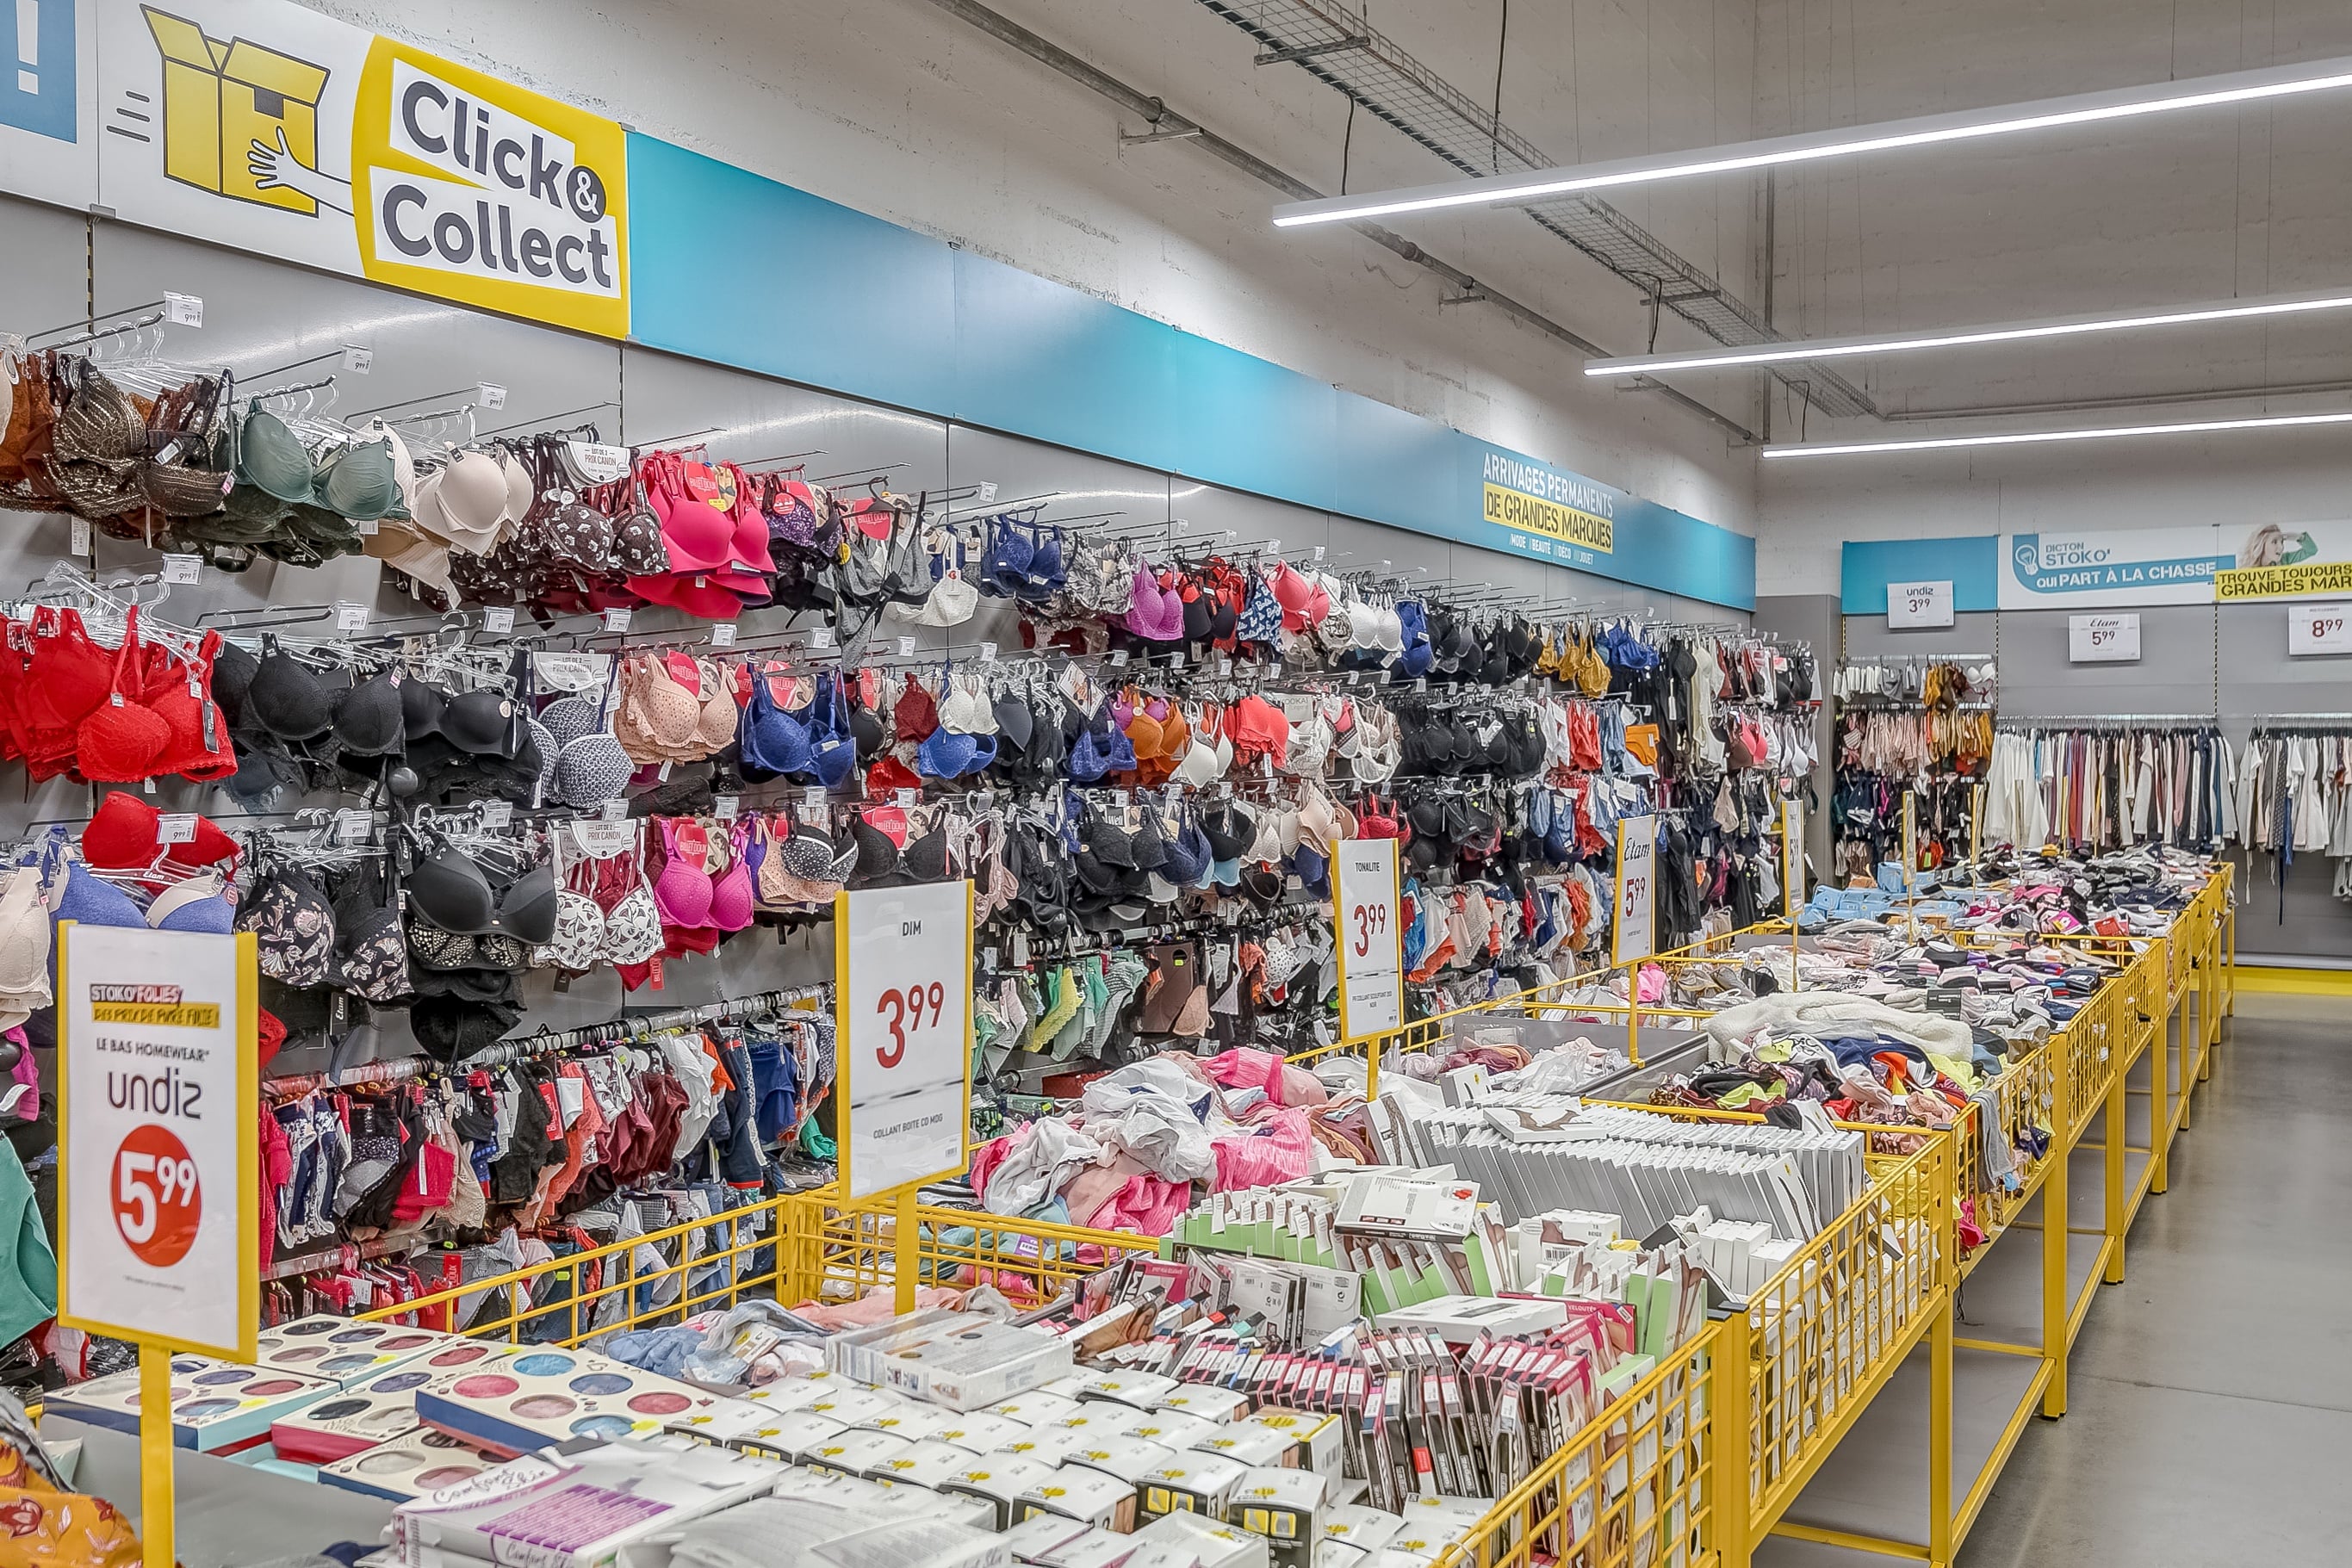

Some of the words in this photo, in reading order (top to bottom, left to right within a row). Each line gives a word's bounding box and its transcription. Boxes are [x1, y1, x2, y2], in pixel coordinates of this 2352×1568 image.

[402, 80, 563, 210] Click
[572, 170, 600, 218] &
[383, 184, 611, 288] Collect
[585, 454, 598, 464] PRIX
[598, 456, 617, 467] CANON
[1483, 452, 1546, 497] ARRIVAGES
[1548, 473, 1613, 518] PERMANENTS
[1486, 491, 1500, 518] DE
[1505, 493, 1559, 534] GRANDES
[1561, 511, 1611, 548] MARQUES
[2045, 542, 2084, 553] DICTON
[2036, 575, 2057, 588] QUI
[2059, 571, 2101, 586] PART
[2107, 567, 2118, 583] À
[2122, 568, 2144, 582] LA
[2149, 561, 2216, 579] CHASSE
[1906, 586, 1933, 597] undiz
[2221, 579, 2304, 597] GRANDES
[1908, 598, 1931, 613] 399
[2092, 630, 2116, 645] 599
[2312, 618, 2343, 638] 899
[587, 832, 600, 841] PRIX
[601, 831, 621, 840] CANON
[1624, 838, 1650, 862] Etam
[143, 871, 165, 881] Etam
[1355, 862, 1381, 872] TONALITE
[1625, 877, 1646, 918] 599
[902, 920, 922, 937] DIM
[1354, 903, 1387, 958] 399
[335, 996, 344, 1020] Etam
[876, 981, 945, 1069] 399
[96, 1038, 107, 1051] LE
[110, 1038, 132, 1054] BAS
[109, 1067, 202, 1119] undiz
[873, 1123, 902, 1139] COLLANT
[903, 1119, 920, 1132] BOITE
[120, 1150, 197, 1245] 599
